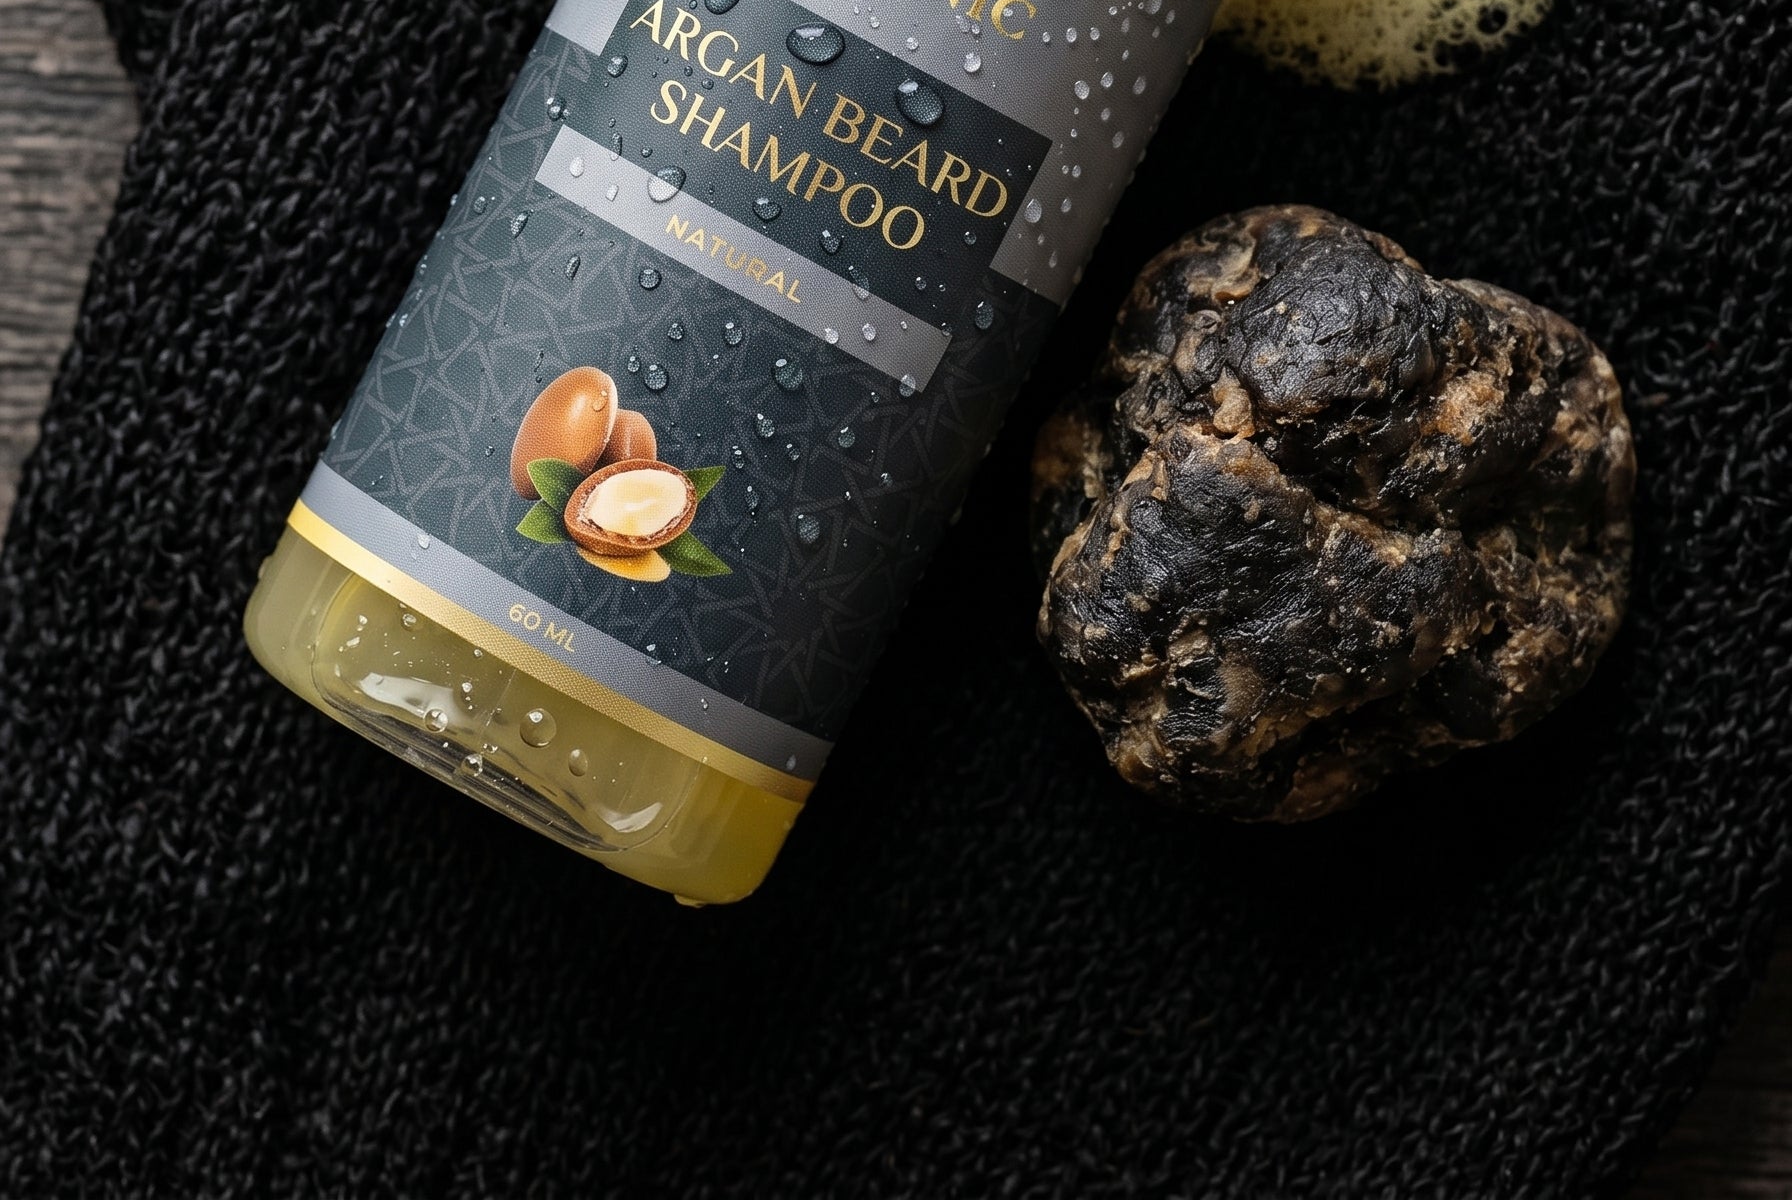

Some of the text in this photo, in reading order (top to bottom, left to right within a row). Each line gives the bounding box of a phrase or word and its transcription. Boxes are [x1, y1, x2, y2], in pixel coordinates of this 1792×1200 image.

[650, 79, 925, 250] SHAMPOO
[822, 92, 1009, 218] BEARD
[665, 214, 801, 303] NATURAL
[509, 603, 575, 653] 60 ML
